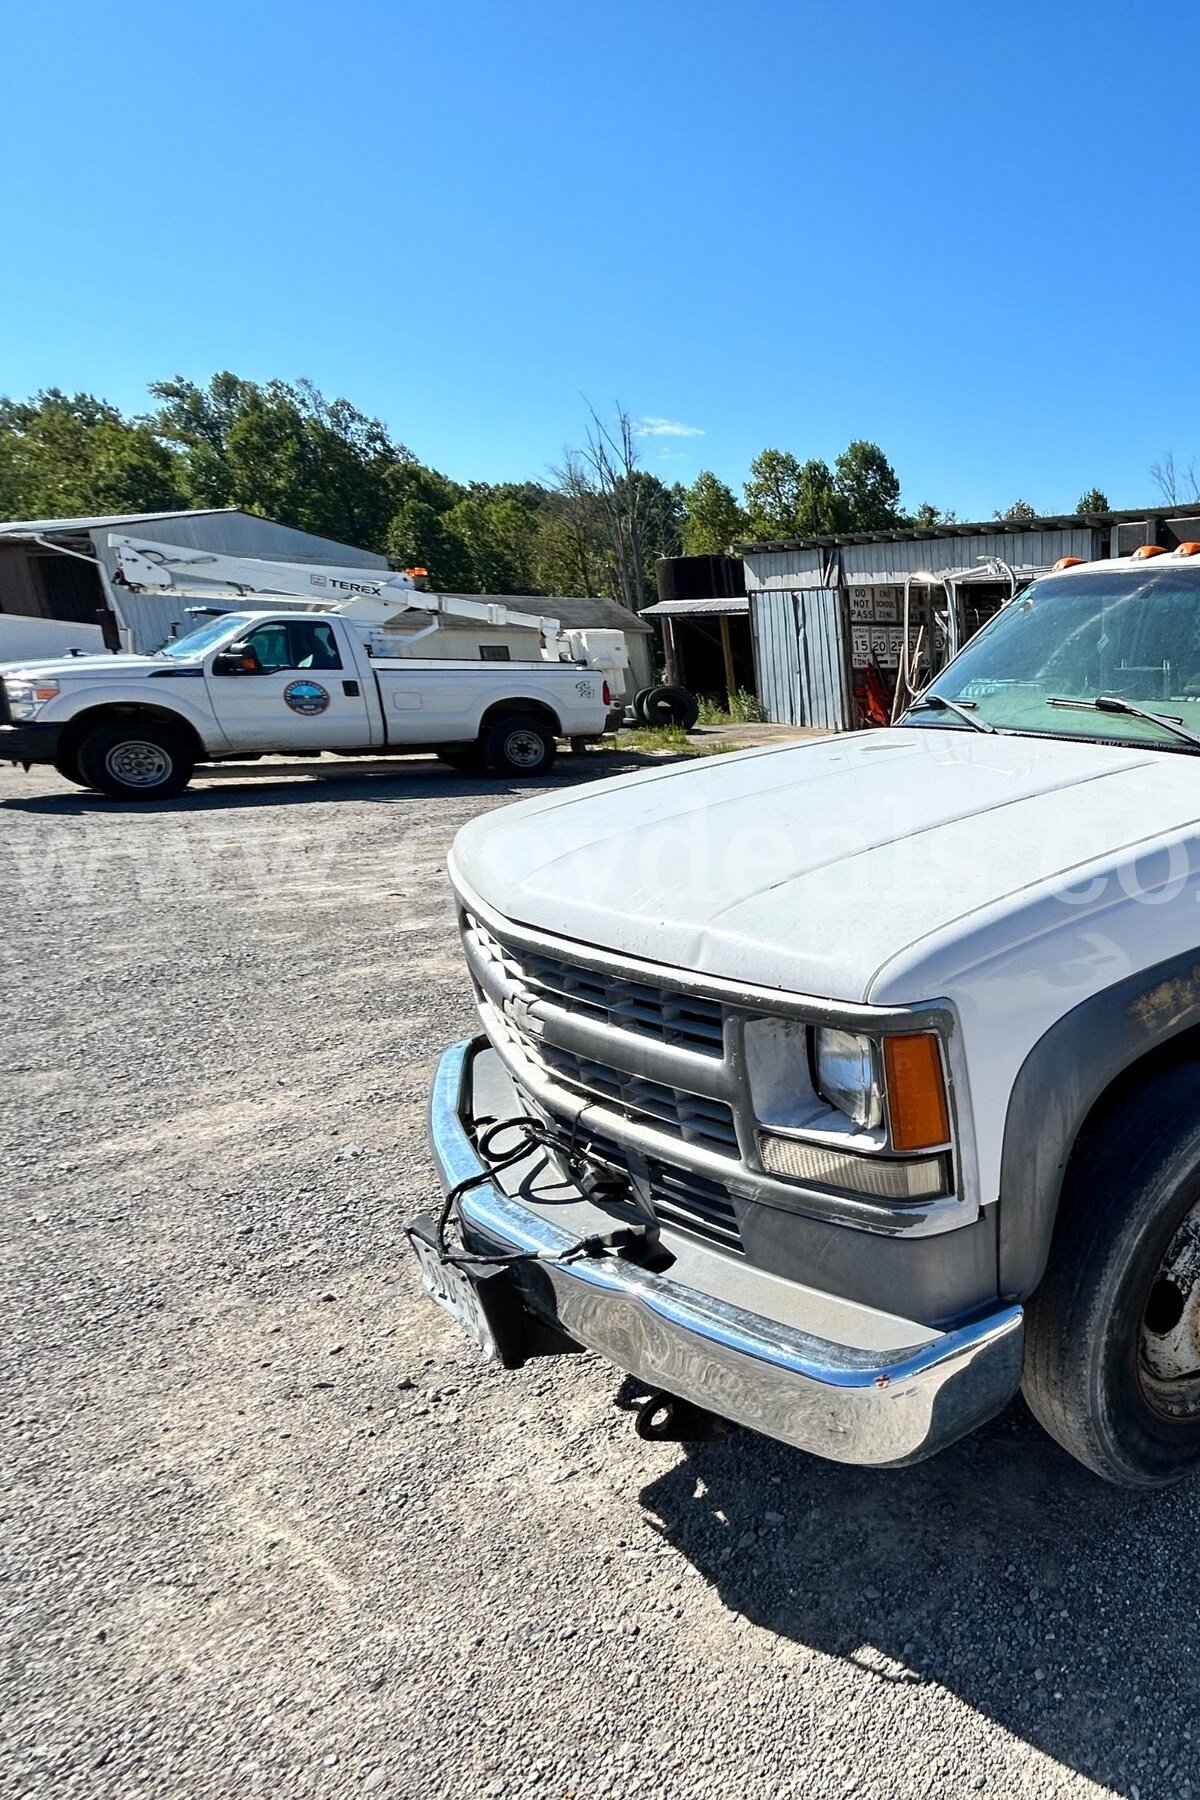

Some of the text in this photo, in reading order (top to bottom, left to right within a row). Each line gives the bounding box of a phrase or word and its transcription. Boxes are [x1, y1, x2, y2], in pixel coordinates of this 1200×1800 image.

[328, 578, 382, 596] TEREX
[854, 589, 866, 598] DO
[853, 600, 869, 608] NOT
[851, 610, 873, 619] PASS
[854, 640, 869, 651] 15
[872, 641, 886, 652] 20
